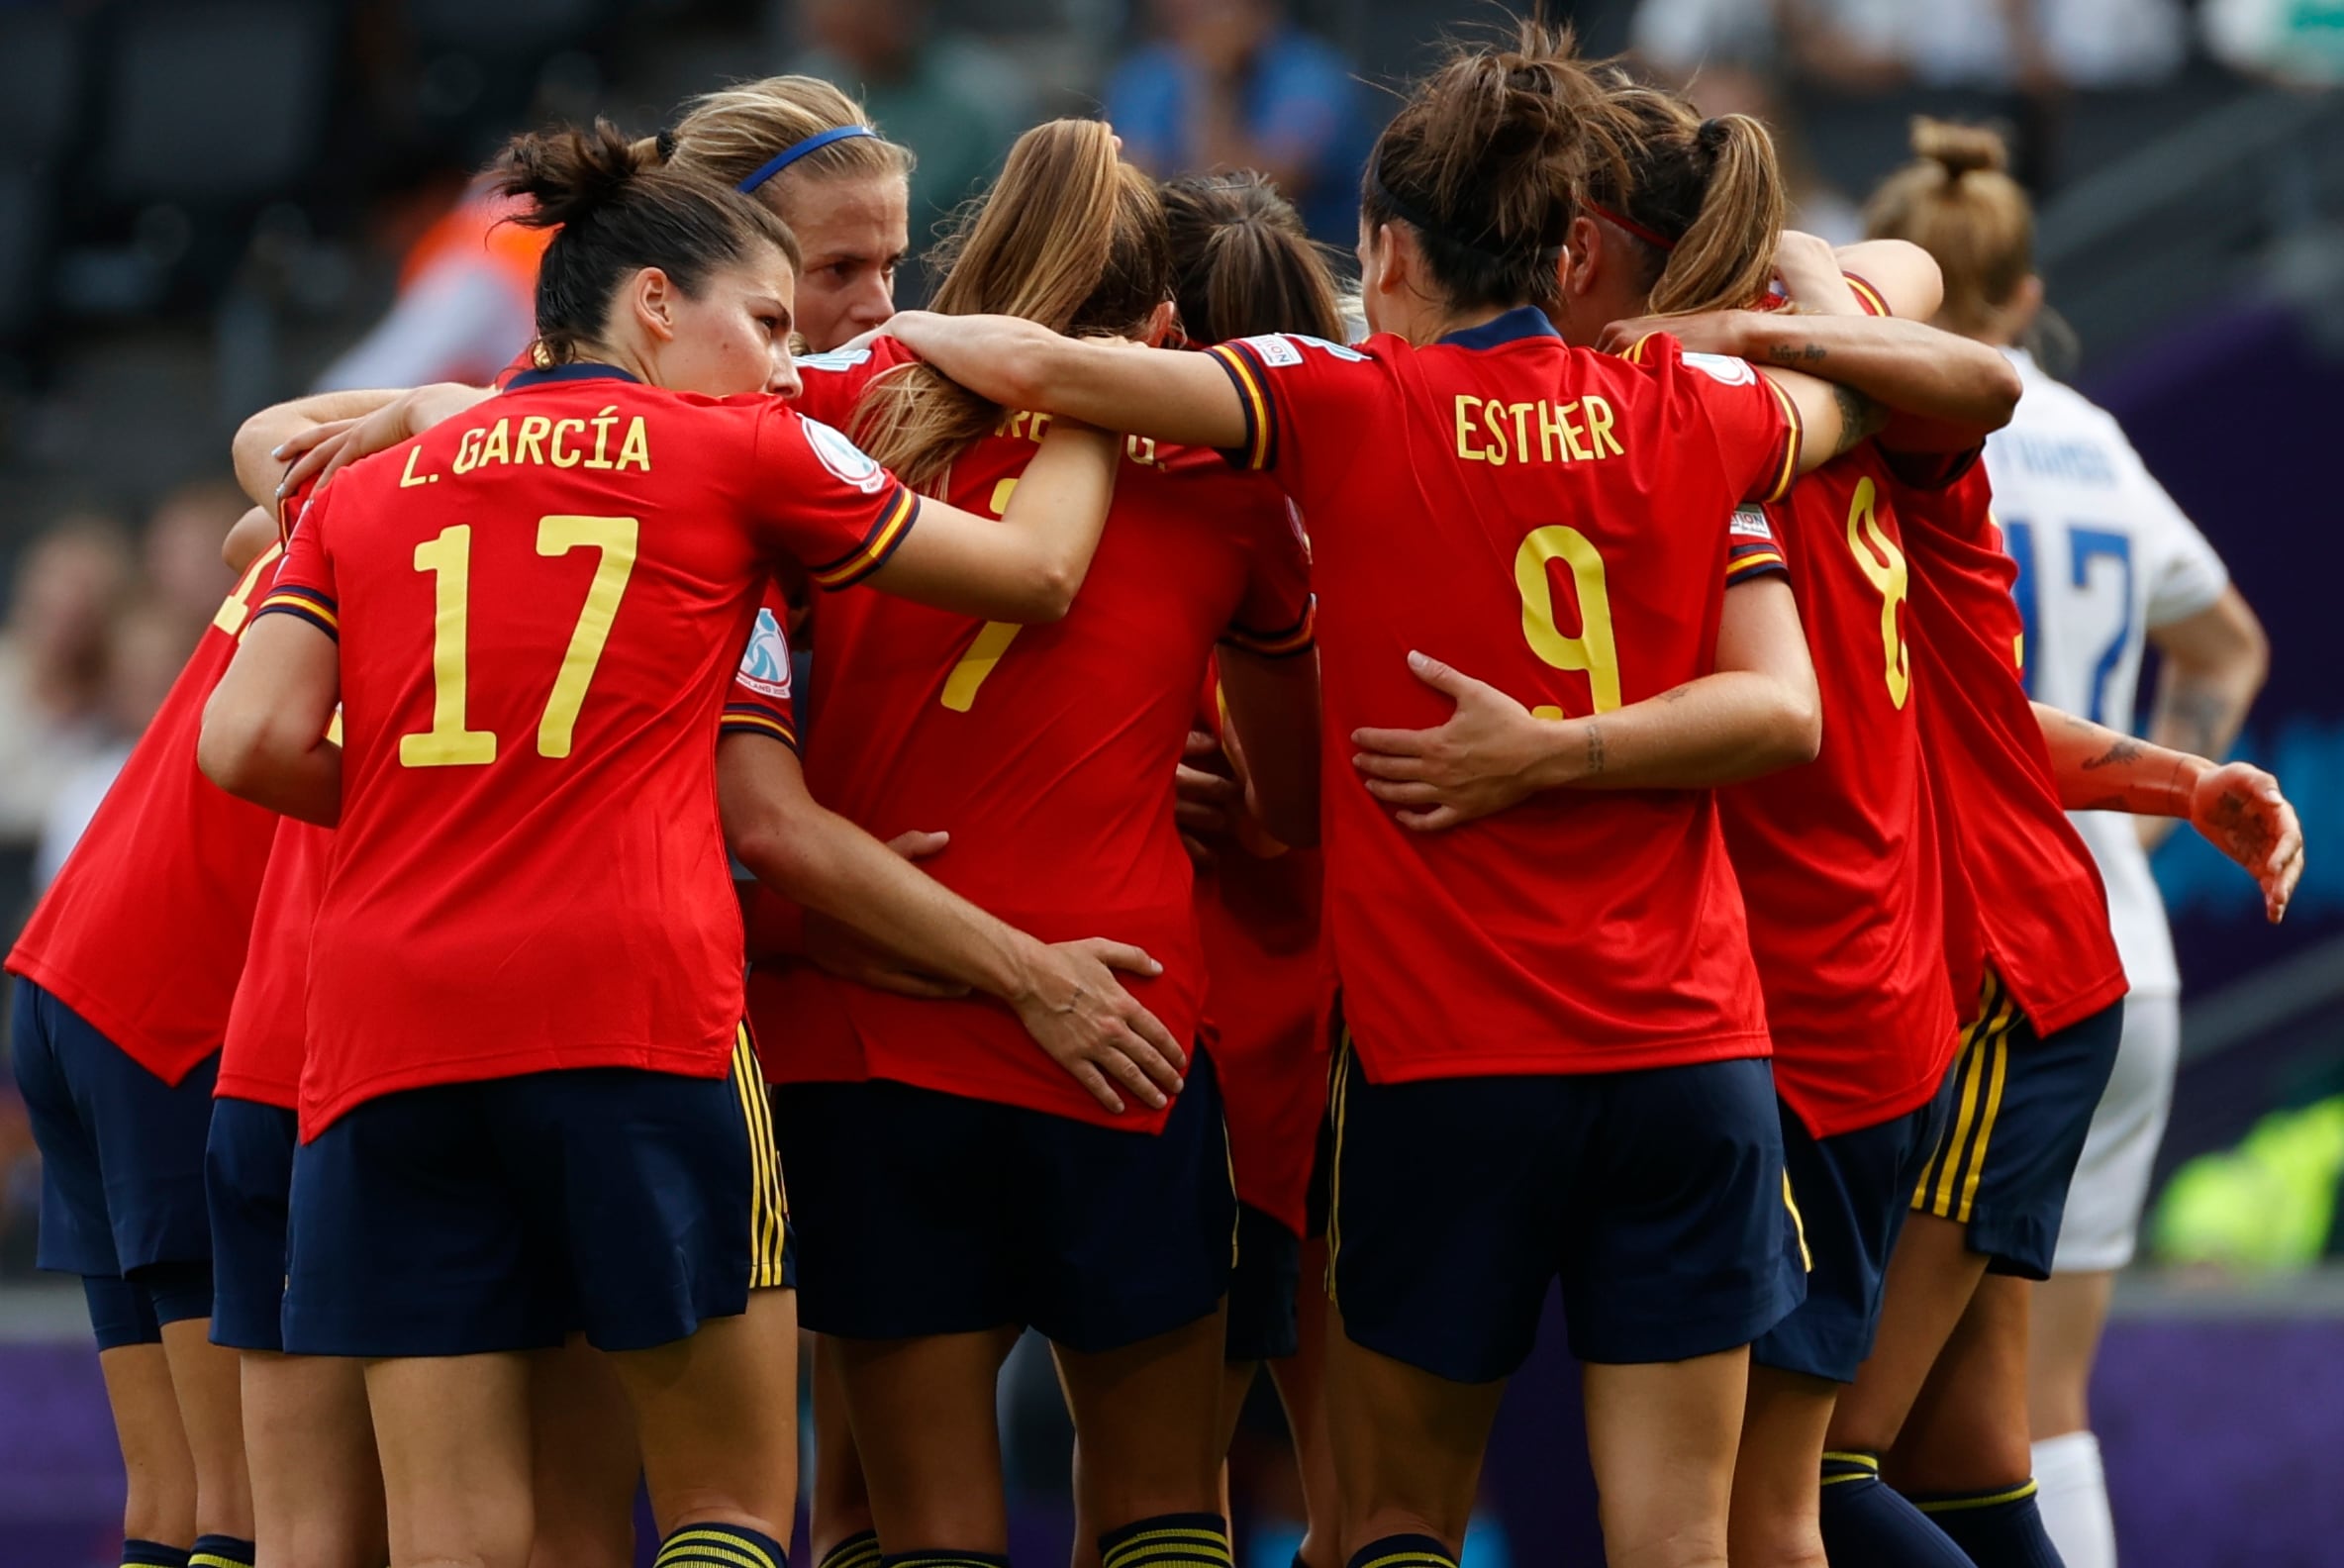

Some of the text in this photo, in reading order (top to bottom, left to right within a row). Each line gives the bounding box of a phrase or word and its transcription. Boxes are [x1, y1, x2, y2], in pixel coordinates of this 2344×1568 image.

[399, 405, 651, 489] L. GARCÍA
[1455, 394, 1624, 465] ESTHER
[399, 514, 639, 768] 17
[1514, 525, 1621, 722] 9
[2004, 520, 2132, 724] 17
